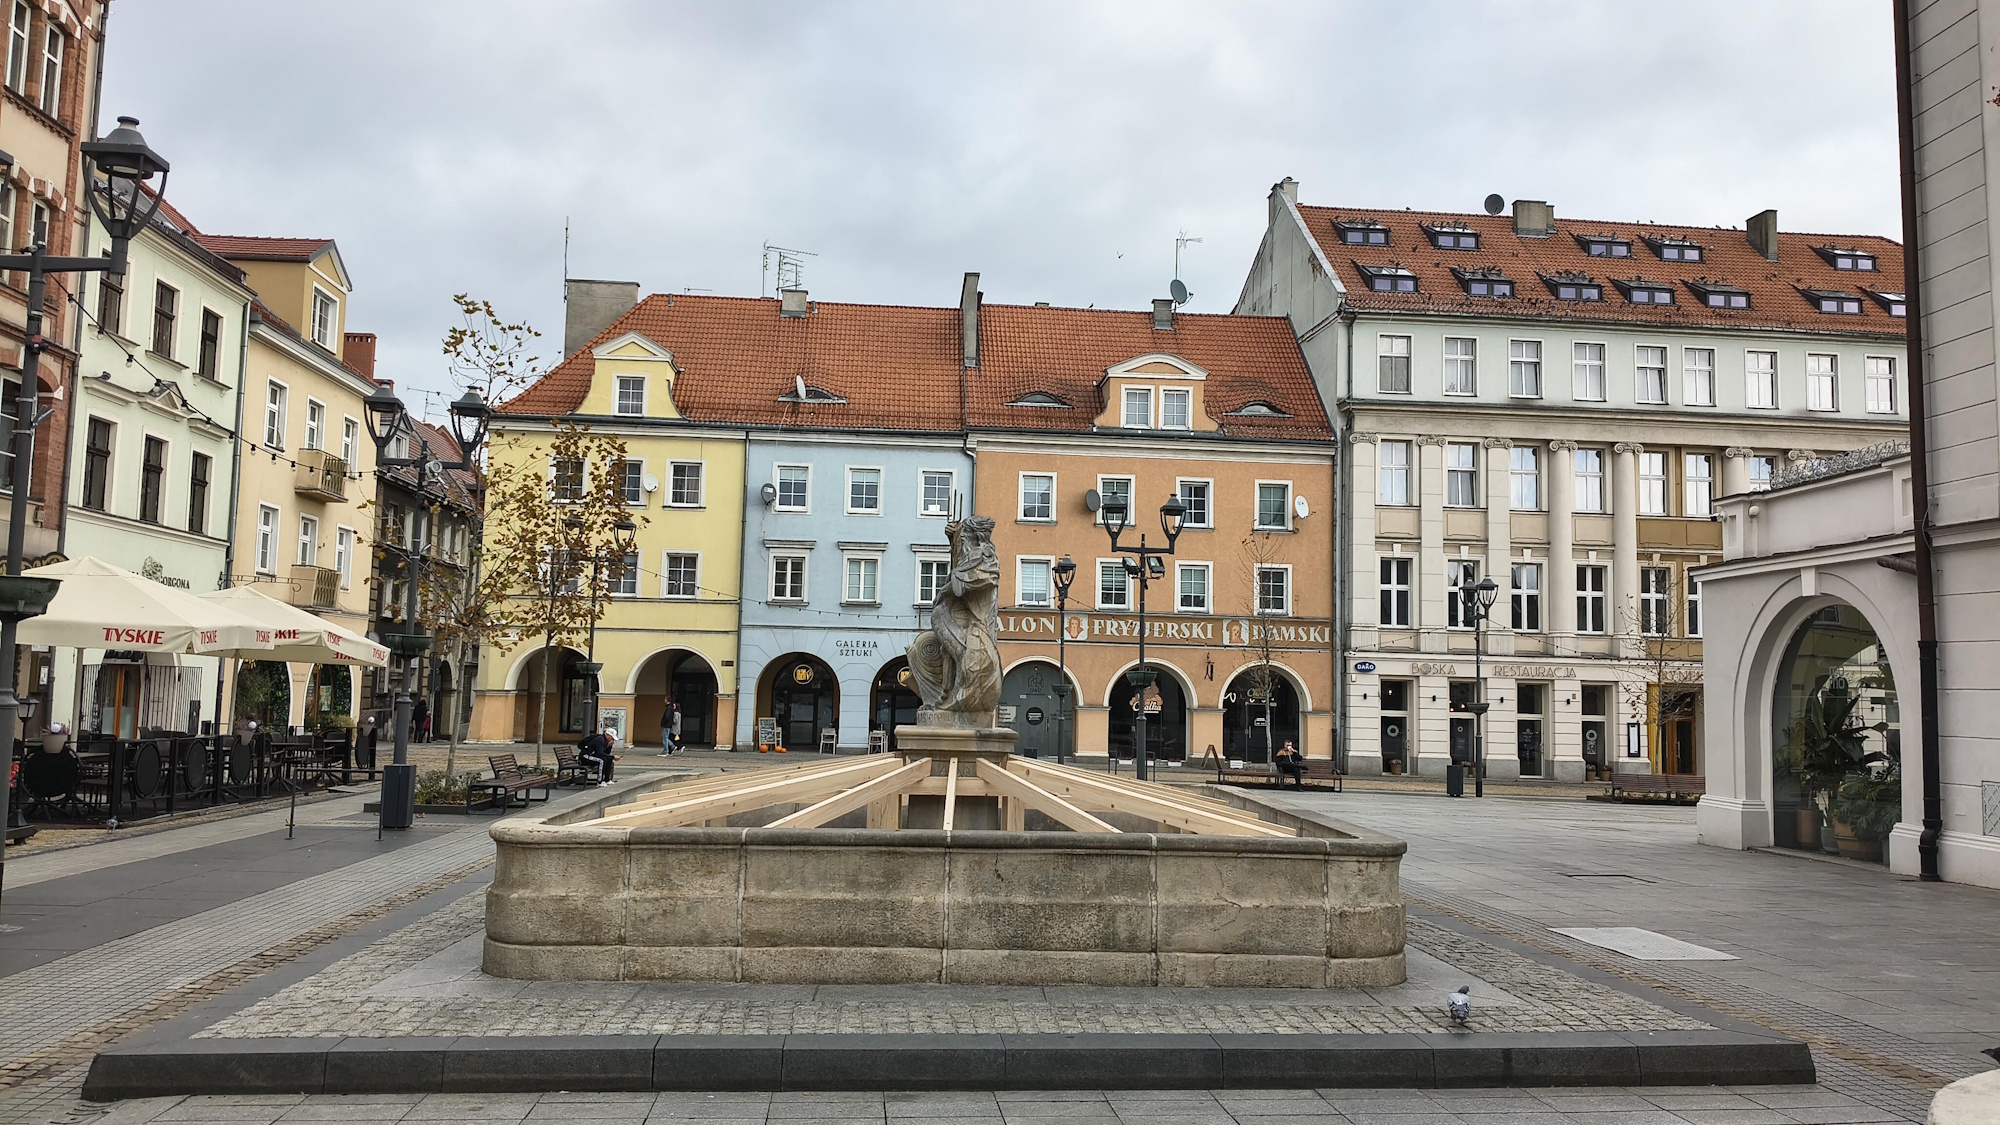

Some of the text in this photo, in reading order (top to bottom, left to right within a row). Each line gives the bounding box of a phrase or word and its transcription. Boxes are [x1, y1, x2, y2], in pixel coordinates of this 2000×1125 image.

[102, 627, 165, 645] TYSKIE
[994, 616, 1331, 643] ALON FRYZJERSKI DAMSKI
[200, 630, 218, 645] TYSKIE
[835, 640, 878, 648] GALERIA
[839, 649, 872, 657] SZTUKI
[1493, 665, 1578, 679] RESTAURACJA
